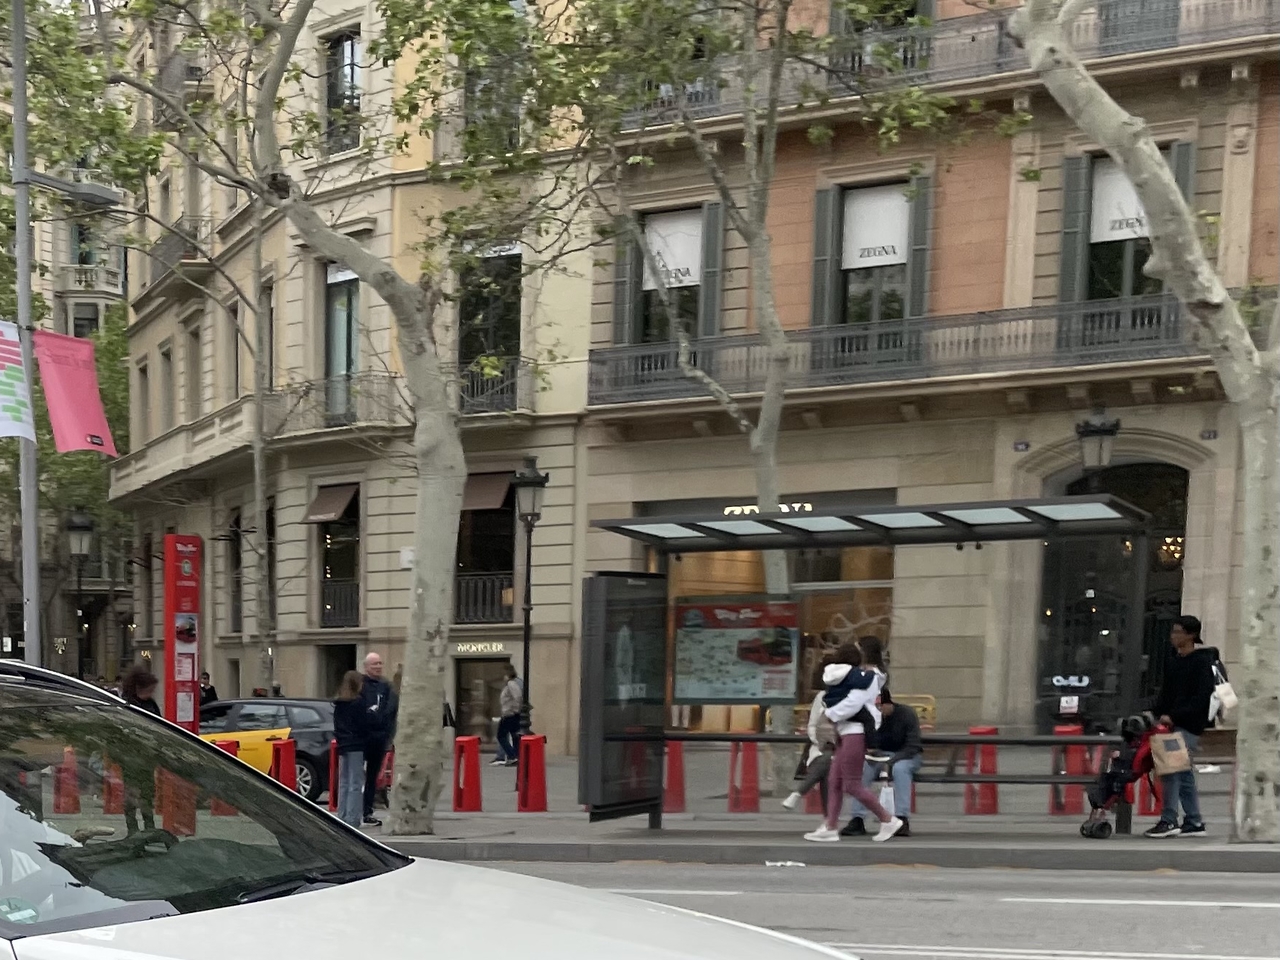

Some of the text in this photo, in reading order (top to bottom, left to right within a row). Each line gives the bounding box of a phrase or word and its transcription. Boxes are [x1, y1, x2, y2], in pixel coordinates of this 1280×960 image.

[1109, 217, 1144, 231] ZEGN
[859, 244, 898, 258] ZEGNA
[456, 642, 505, 653] MONCLER
